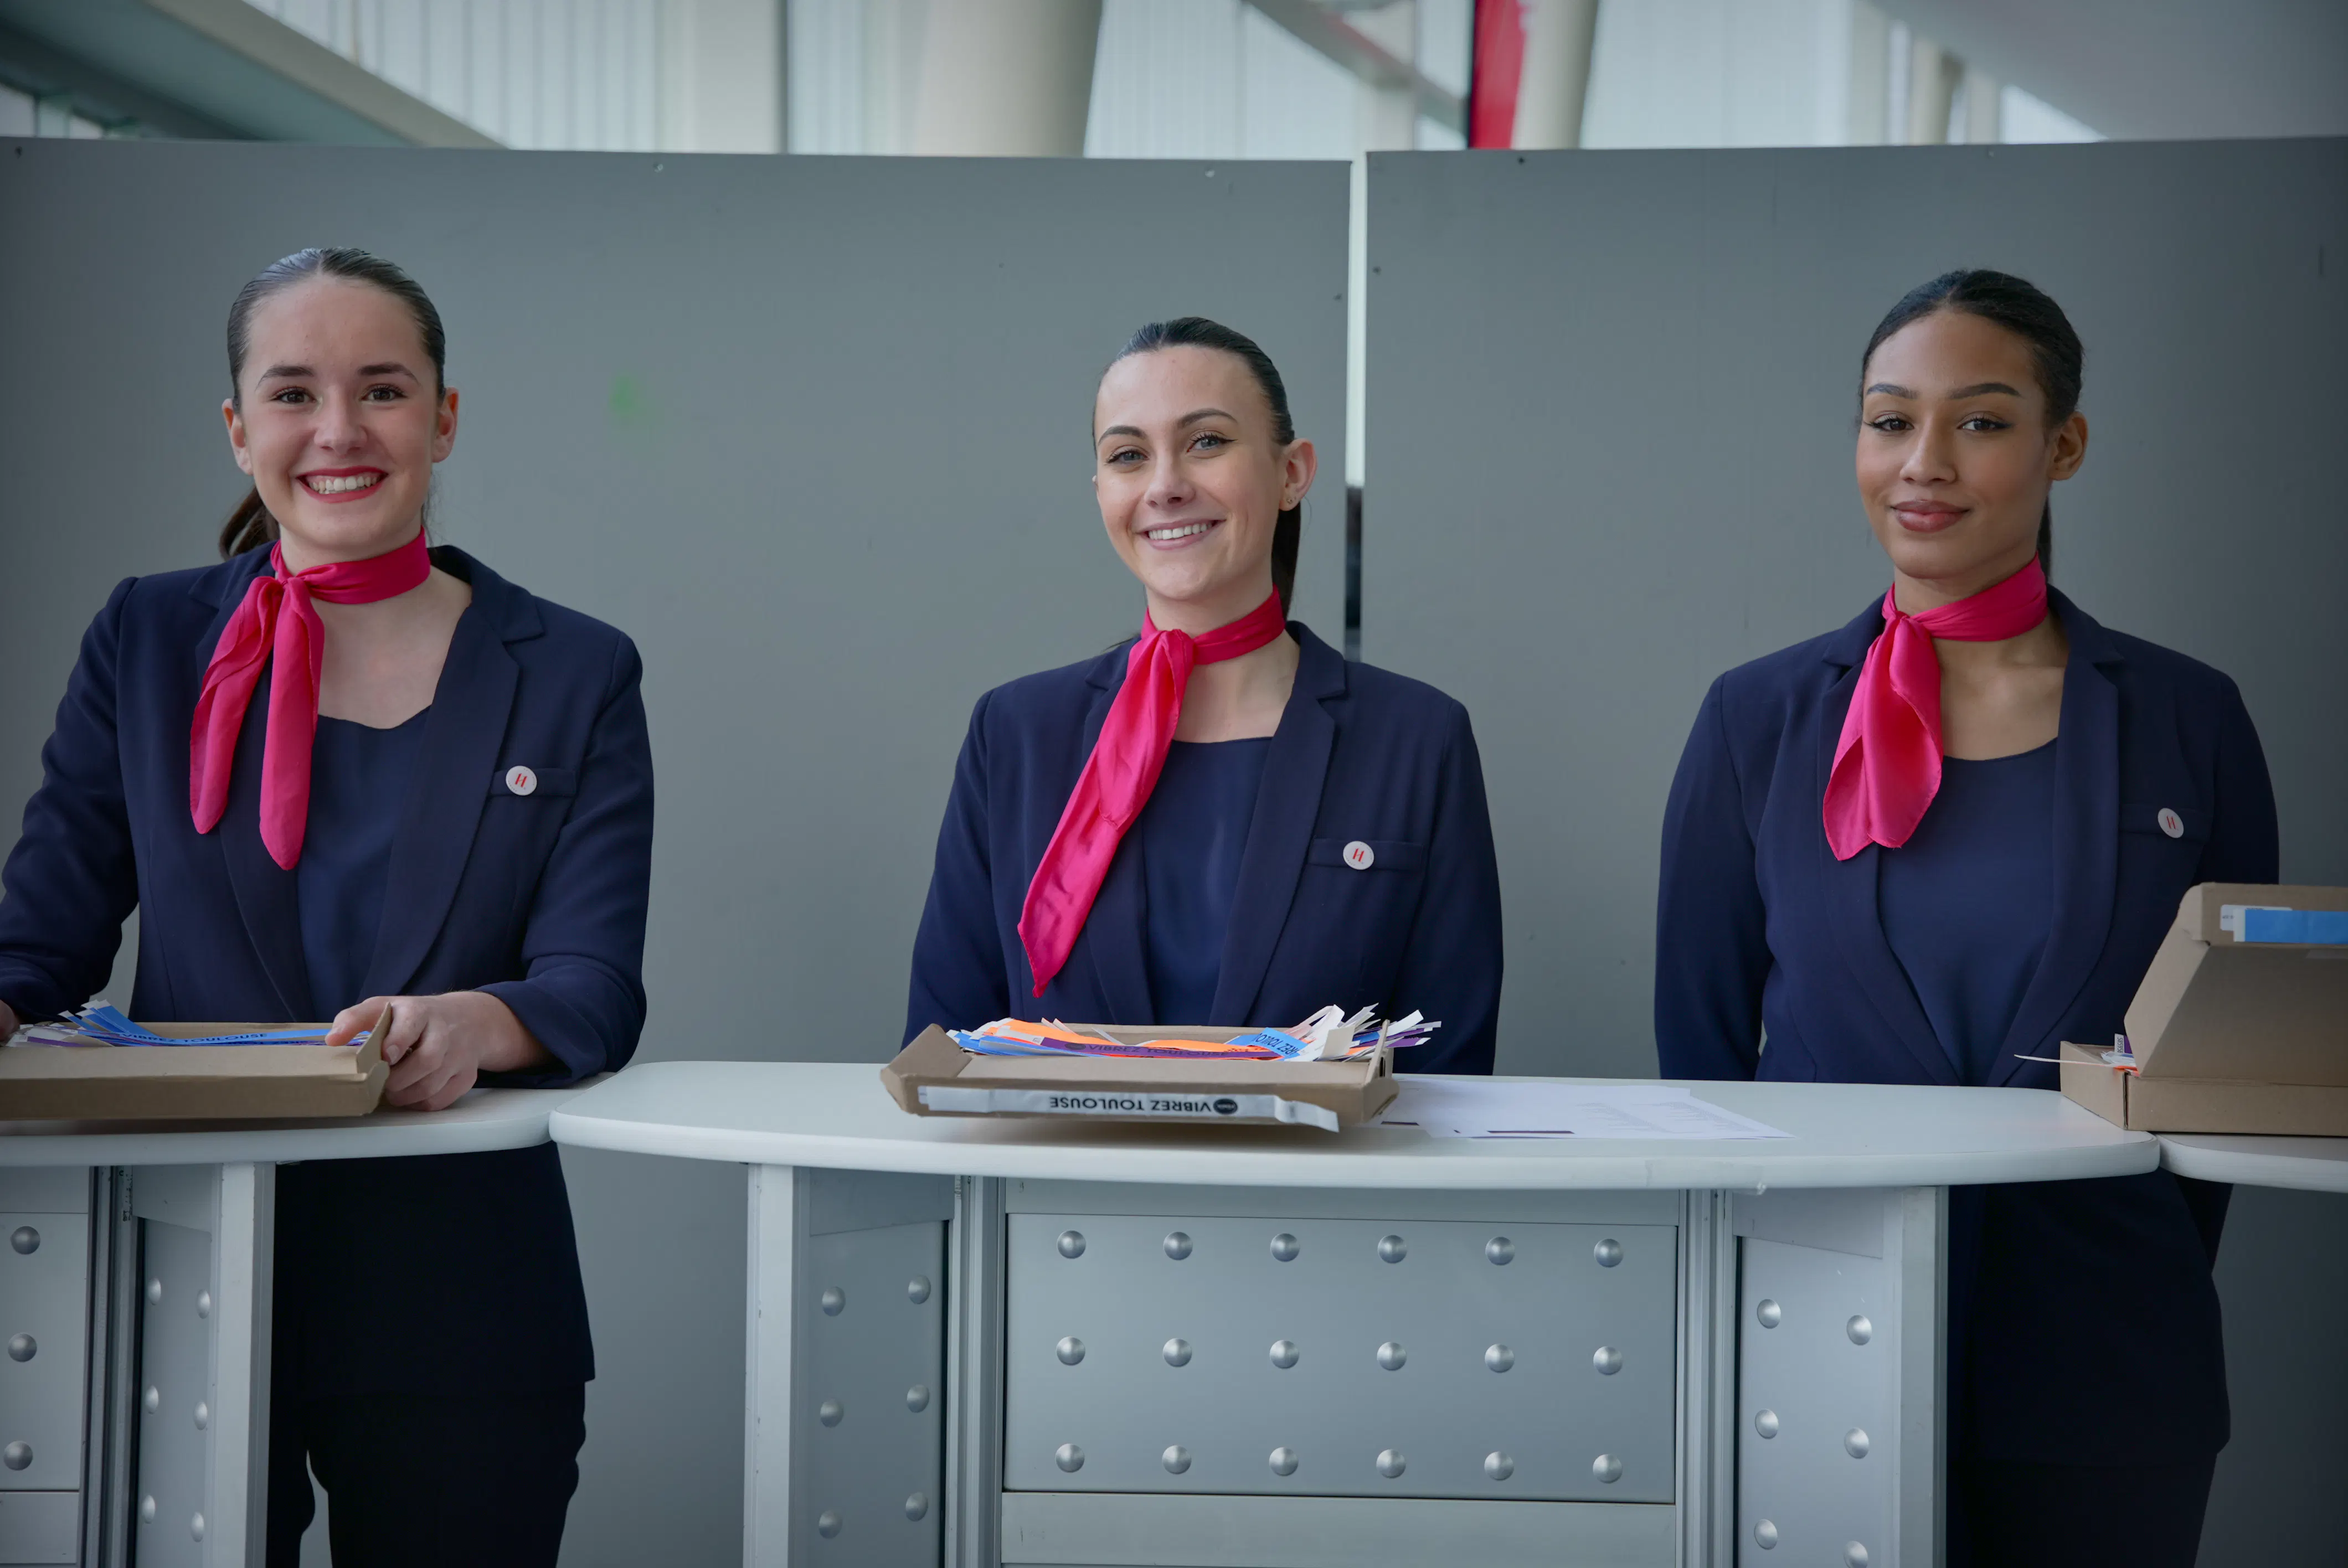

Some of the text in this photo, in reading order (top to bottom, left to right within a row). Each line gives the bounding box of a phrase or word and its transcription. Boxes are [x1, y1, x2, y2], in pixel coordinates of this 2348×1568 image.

[122, 1033, 177, 1043] VIBREZ
[183, 1033, 267, 1043] TOULOUSE
[1050, 1097, 1145, 1111] TOULOUSE
[1151, 1100, 1212, 1112] VIBREZ
